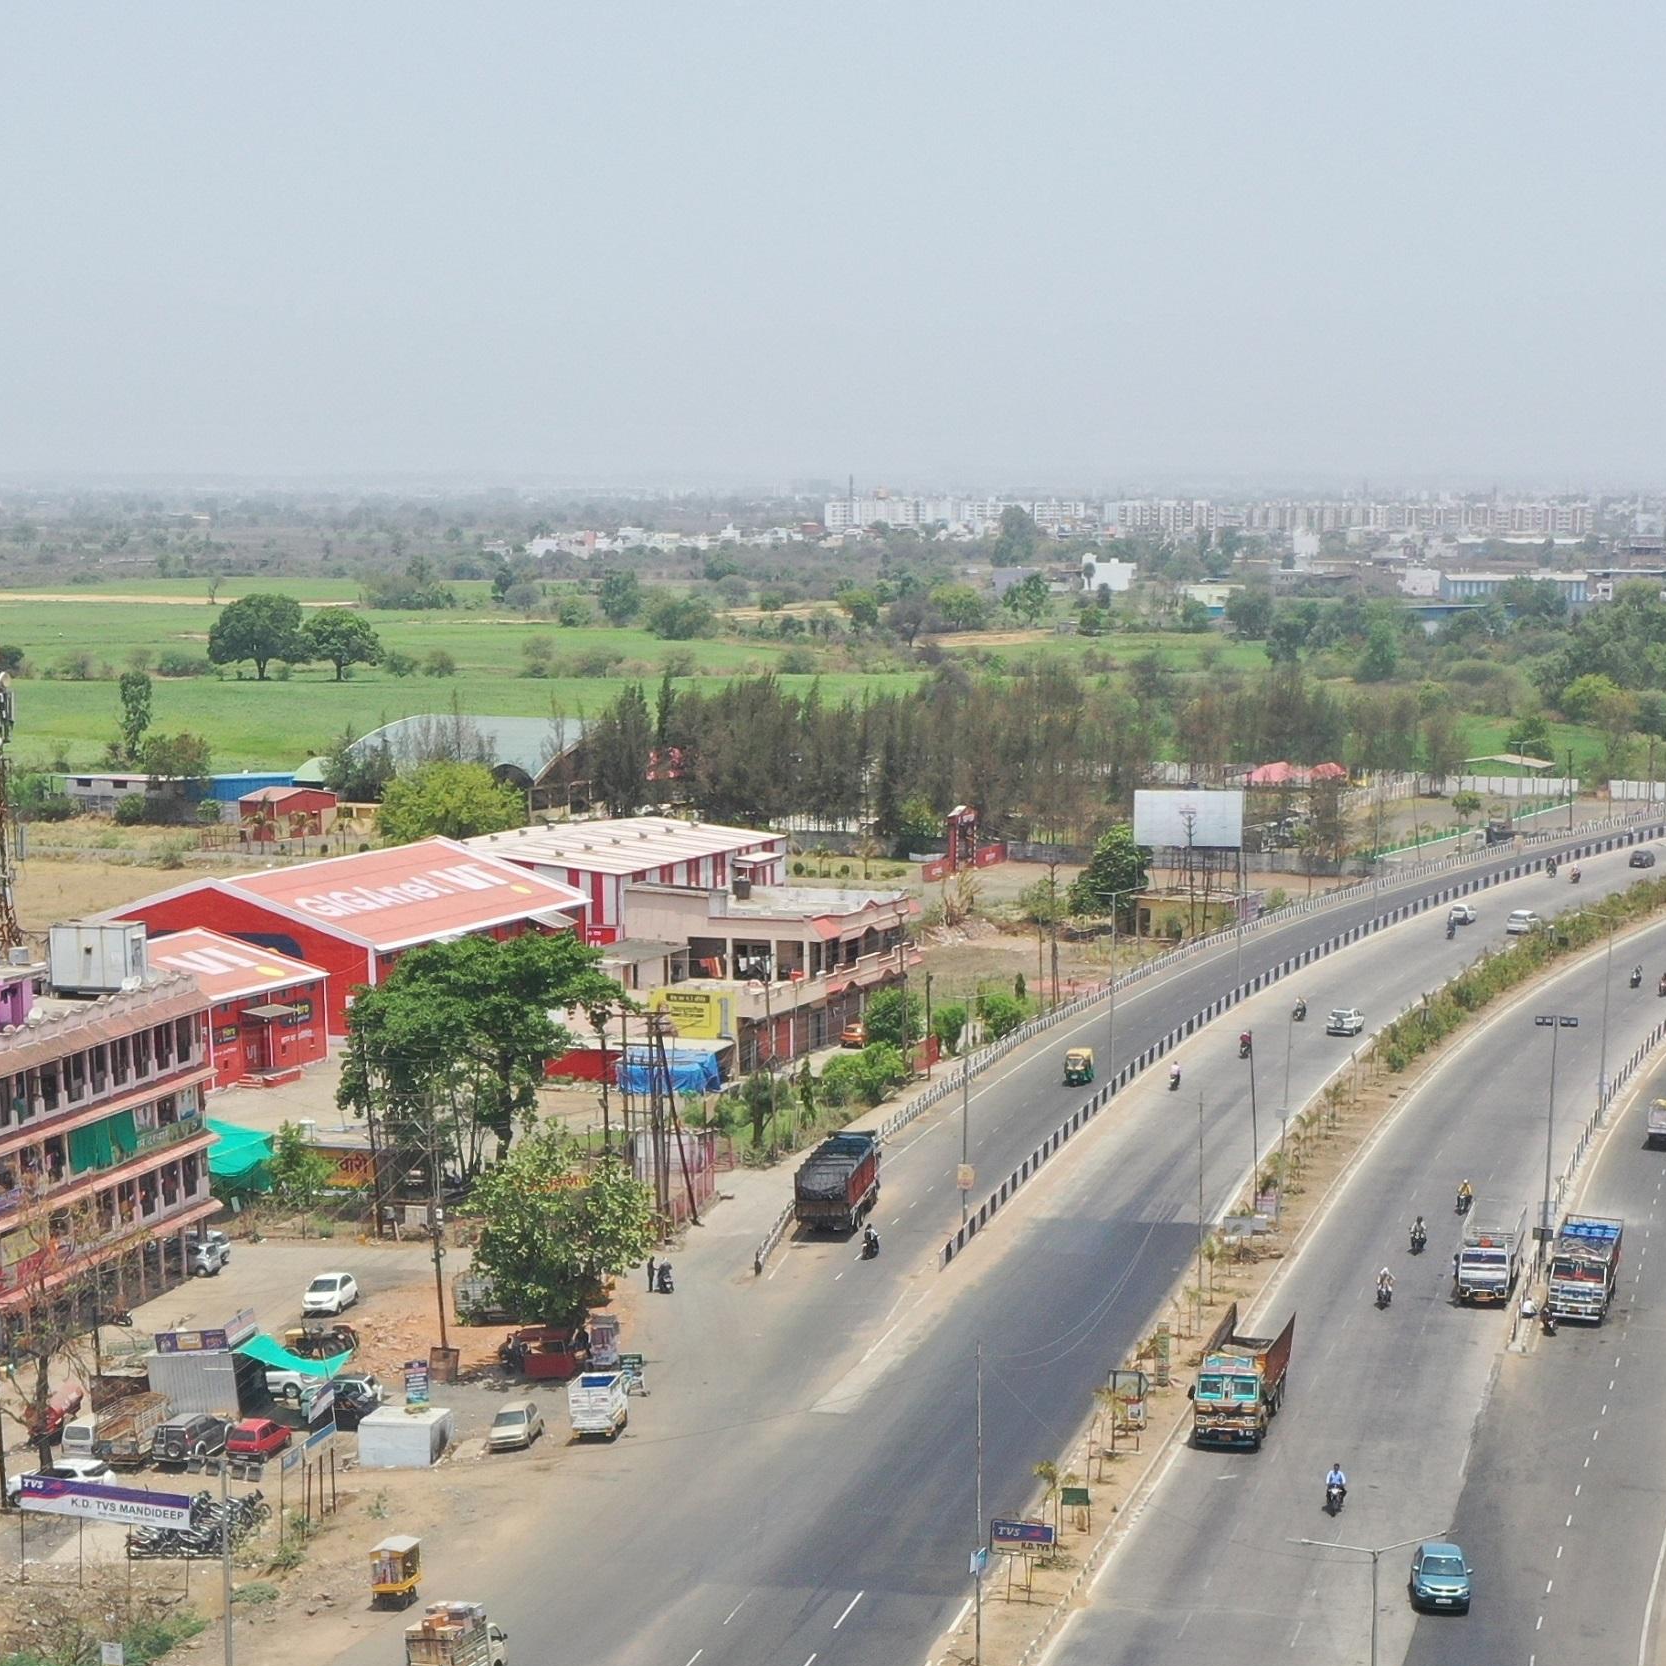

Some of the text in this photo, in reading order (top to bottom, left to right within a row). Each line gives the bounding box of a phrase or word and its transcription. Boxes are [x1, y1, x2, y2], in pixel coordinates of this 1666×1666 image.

[23, 1478, 44, 1489] TVS
[71, 1497, 92, 1509] K.D.
[96, 1500, 116, 1512] TVS
[119, 1503, 184, 1521] MANDIDEEP
[997, 1526, 1021, 1537] TVS
[1036, 1542, 1050, 1552] TVS
